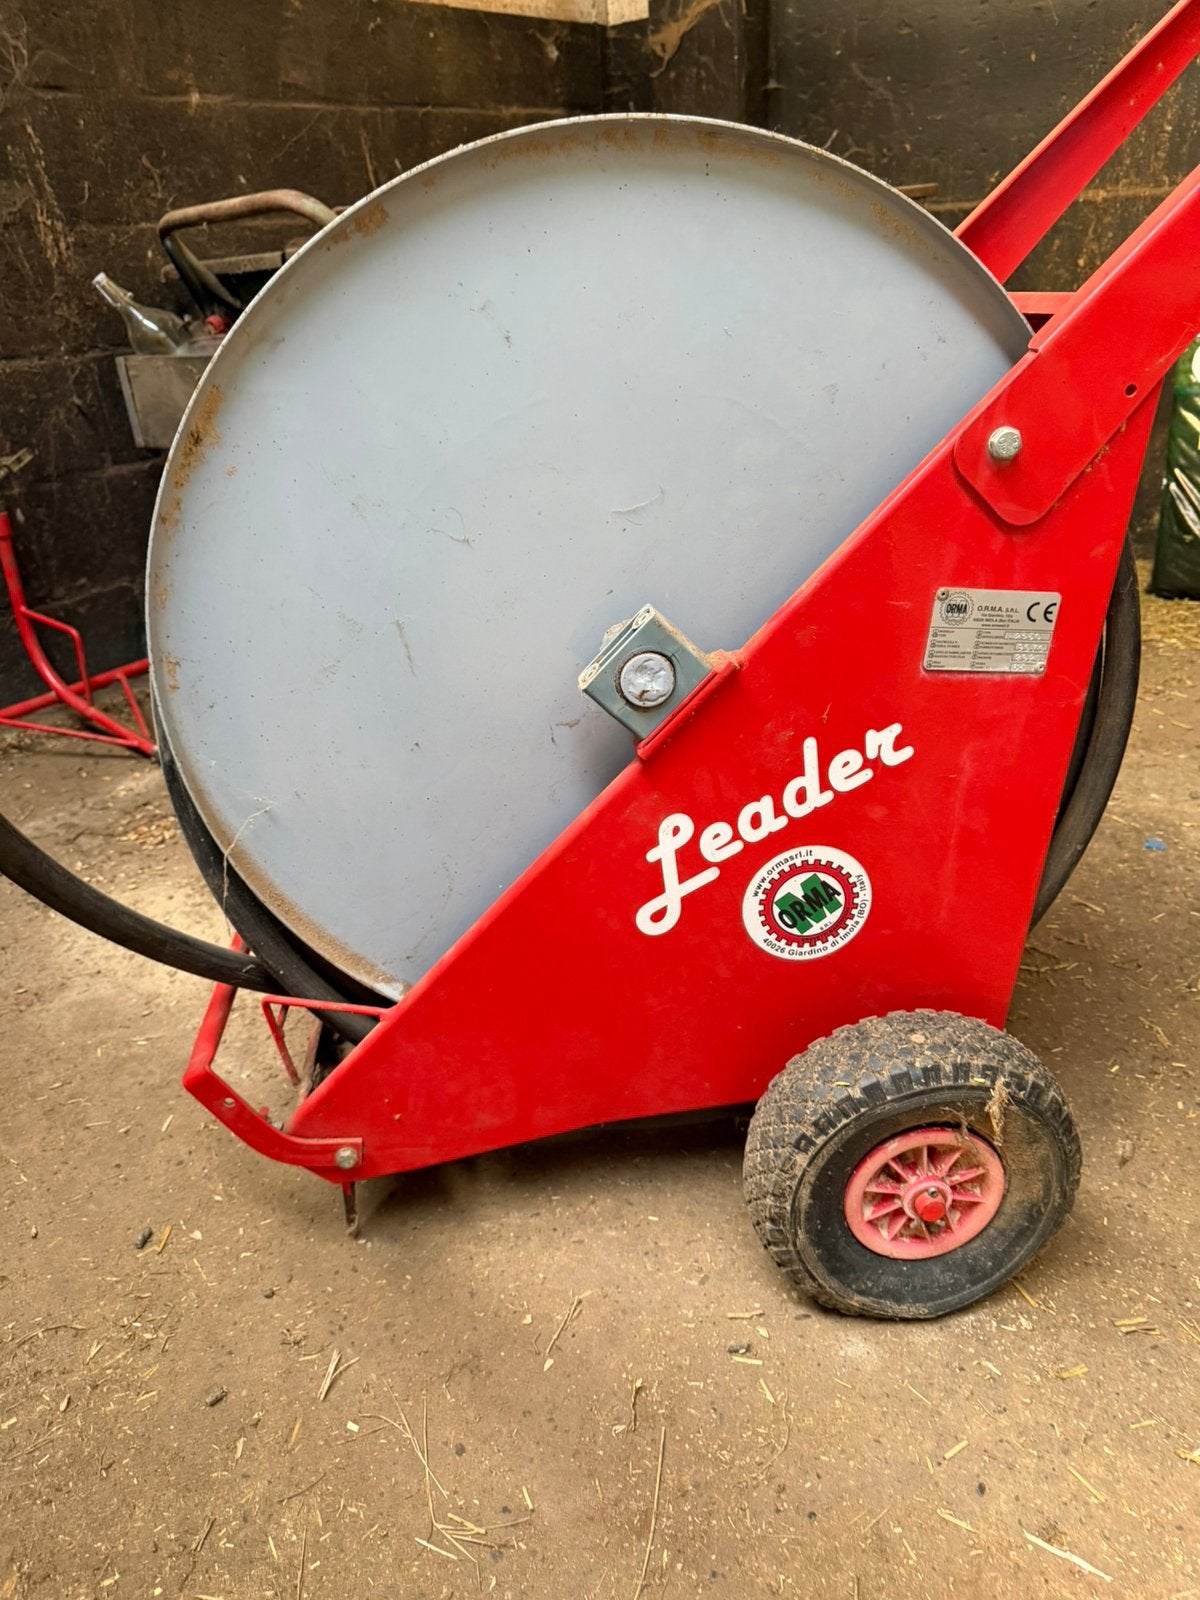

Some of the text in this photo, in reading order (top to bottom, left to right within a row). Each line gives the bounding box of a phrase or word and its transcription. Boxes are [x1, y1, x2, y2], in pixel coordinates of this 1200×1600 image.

[946, 602, 968, 615] ORMA
[635, 722, 915, 936] Leader
[752, 849, 813, 898] www.ormasrl.it
[855, 874, 868, 893] Italy
[778, 880, 842, 929] ORMA
[857, 899, 870, 919] (BO)
[840, 920, 861, 942] Imola
[762, 936, 787, 954] 40026
[787, 945, 829, 957] Giardino
[830, 939, 840, 948] di
